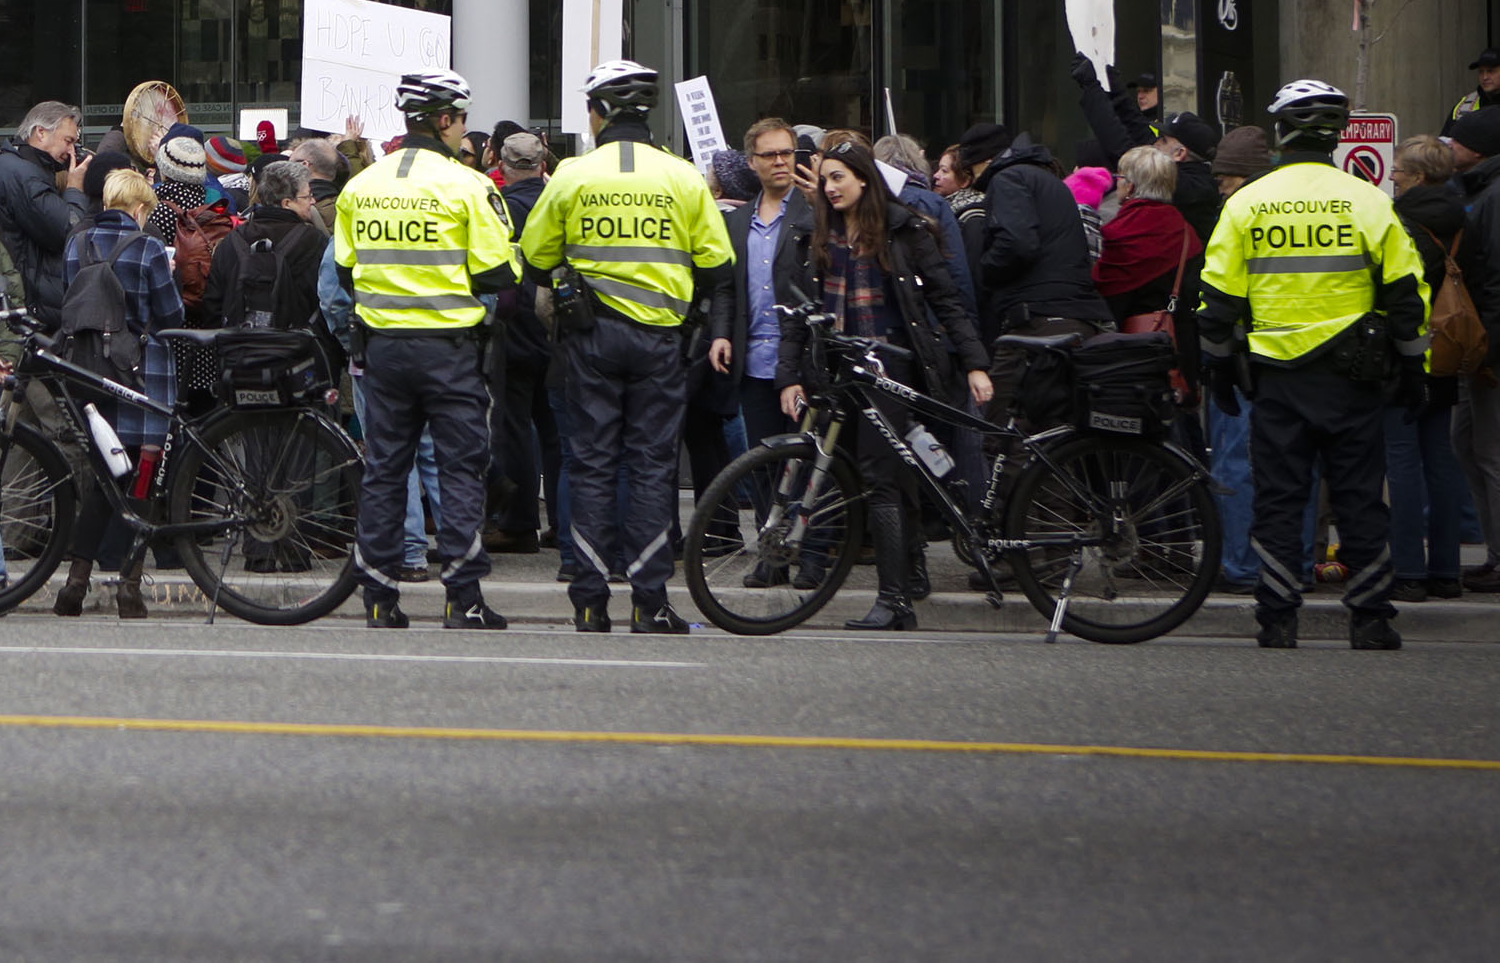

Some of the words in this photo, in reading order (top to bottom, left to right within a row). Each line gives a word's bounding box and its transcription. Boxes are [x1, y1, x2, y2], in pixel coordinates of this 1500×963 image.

[316, 76, 404, 131] BANKRU
[1340, 122, 1391, 139] EMPORARY
[356, 197, 439, 211] VANCOUVER
[580, 193, 674, 209] VANCOUVER
[1250, 200, 1352, 214] VANCOUVER
[356, 220, 438, 242] POLICE
[580, 217, 672, 239] POLICE
[1251, 224, 1353, 250] POLICE
[239, 392, 276, 402] POLICE
[876, 377, 917, 402] POLICE
[1093, 416, 1139, 429] POLICE
[156, 433, 173, 486] POLICE
[981, 453, 1006, 509] POLICE
[988, 539, 1030, 548] POLICE
